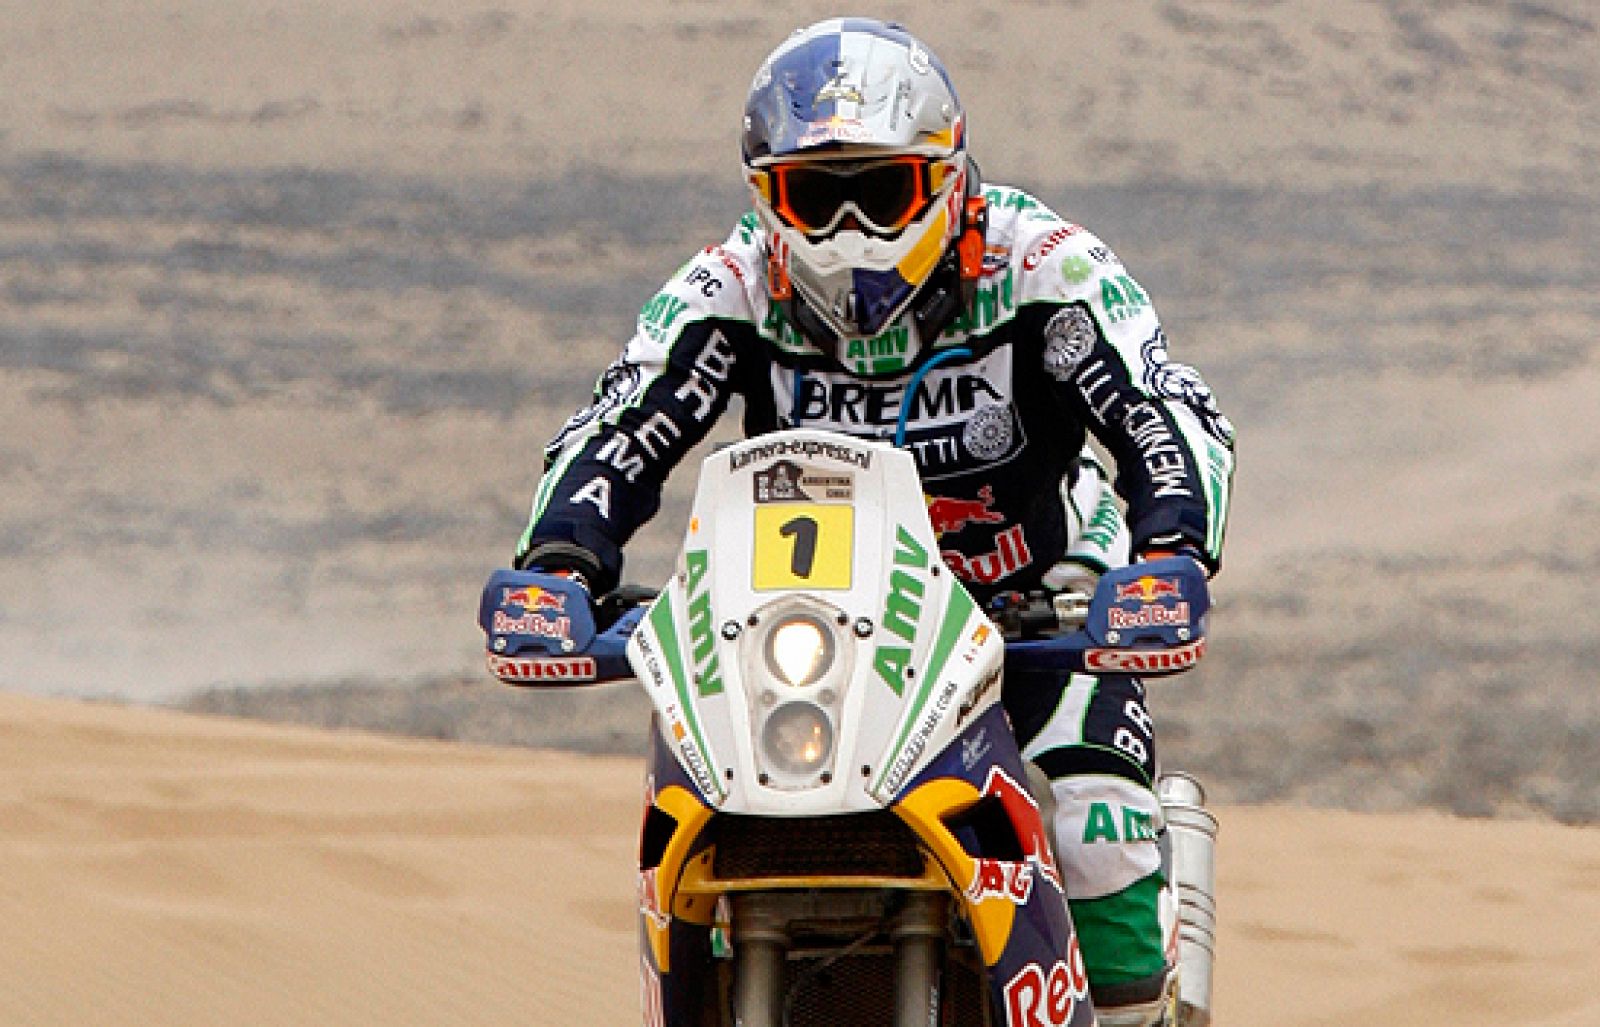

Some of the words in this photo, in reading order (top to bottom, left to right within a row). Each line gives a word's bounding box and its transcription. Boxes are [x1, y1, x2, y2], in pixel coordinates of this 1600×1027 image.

[801, 375, 1004, 425] BREMA
[779, 514, 819, 580] 1
[493, 610, 527, 634] Red
[531, 613, 571, 641] Bull
[1108, 602, 1149, 629] Red
[1150, 600, 1191, 626] Bull
[1086, 642, 1206, 670] Canon
